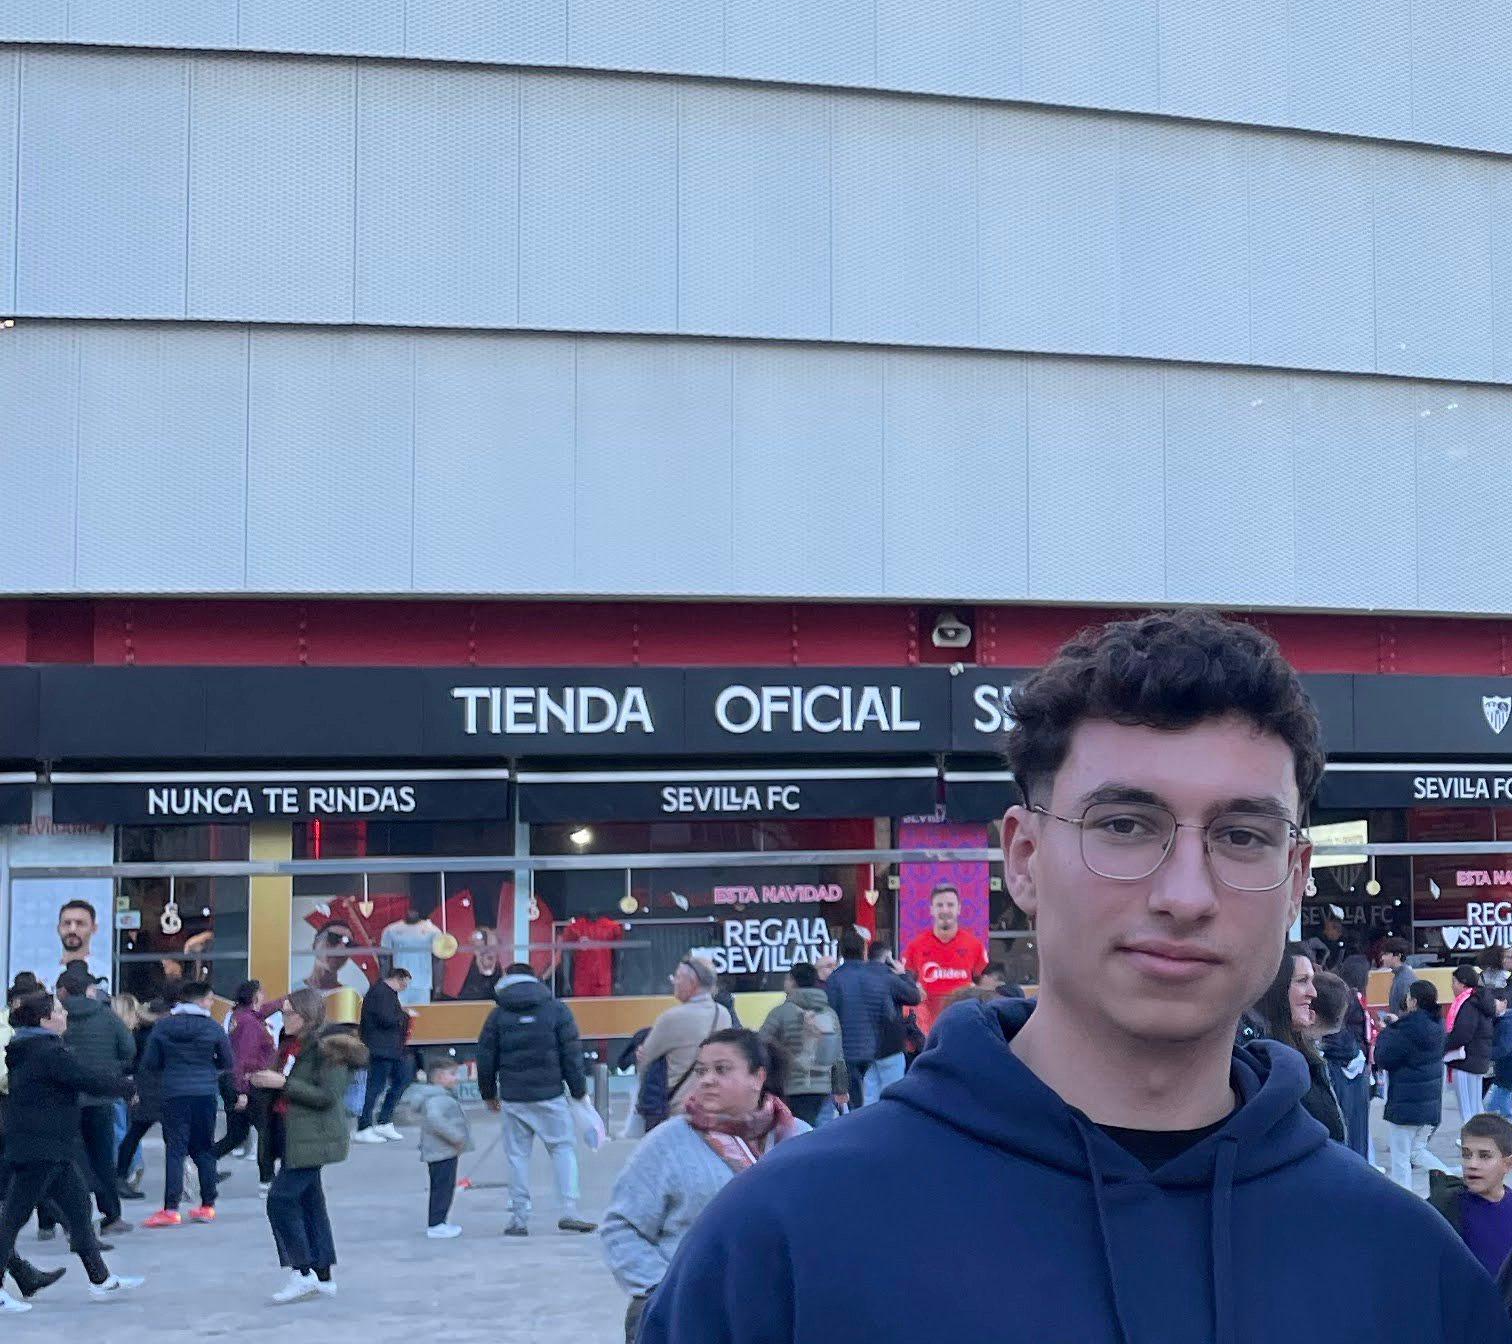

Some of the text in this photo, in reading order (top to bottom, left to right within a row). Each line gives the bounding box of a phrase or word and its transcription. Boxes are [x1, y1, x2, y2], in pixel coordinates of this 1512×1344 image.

[451, 686, 655, 734] TIENDA
[715, 684, 921, 734] OFICIAL
[148, 786, 416, 815] NUNCA TE RINDAS
[662, 785, 800, 812] SEVILLA FC
[1413, 776, 1490, 799] SEVILLA
[1456, 870, 1492, 887] ESTA
[713, 884, 843, 905] ESTA NAVIDAD
[723, 917, 832, 947] REGALA
